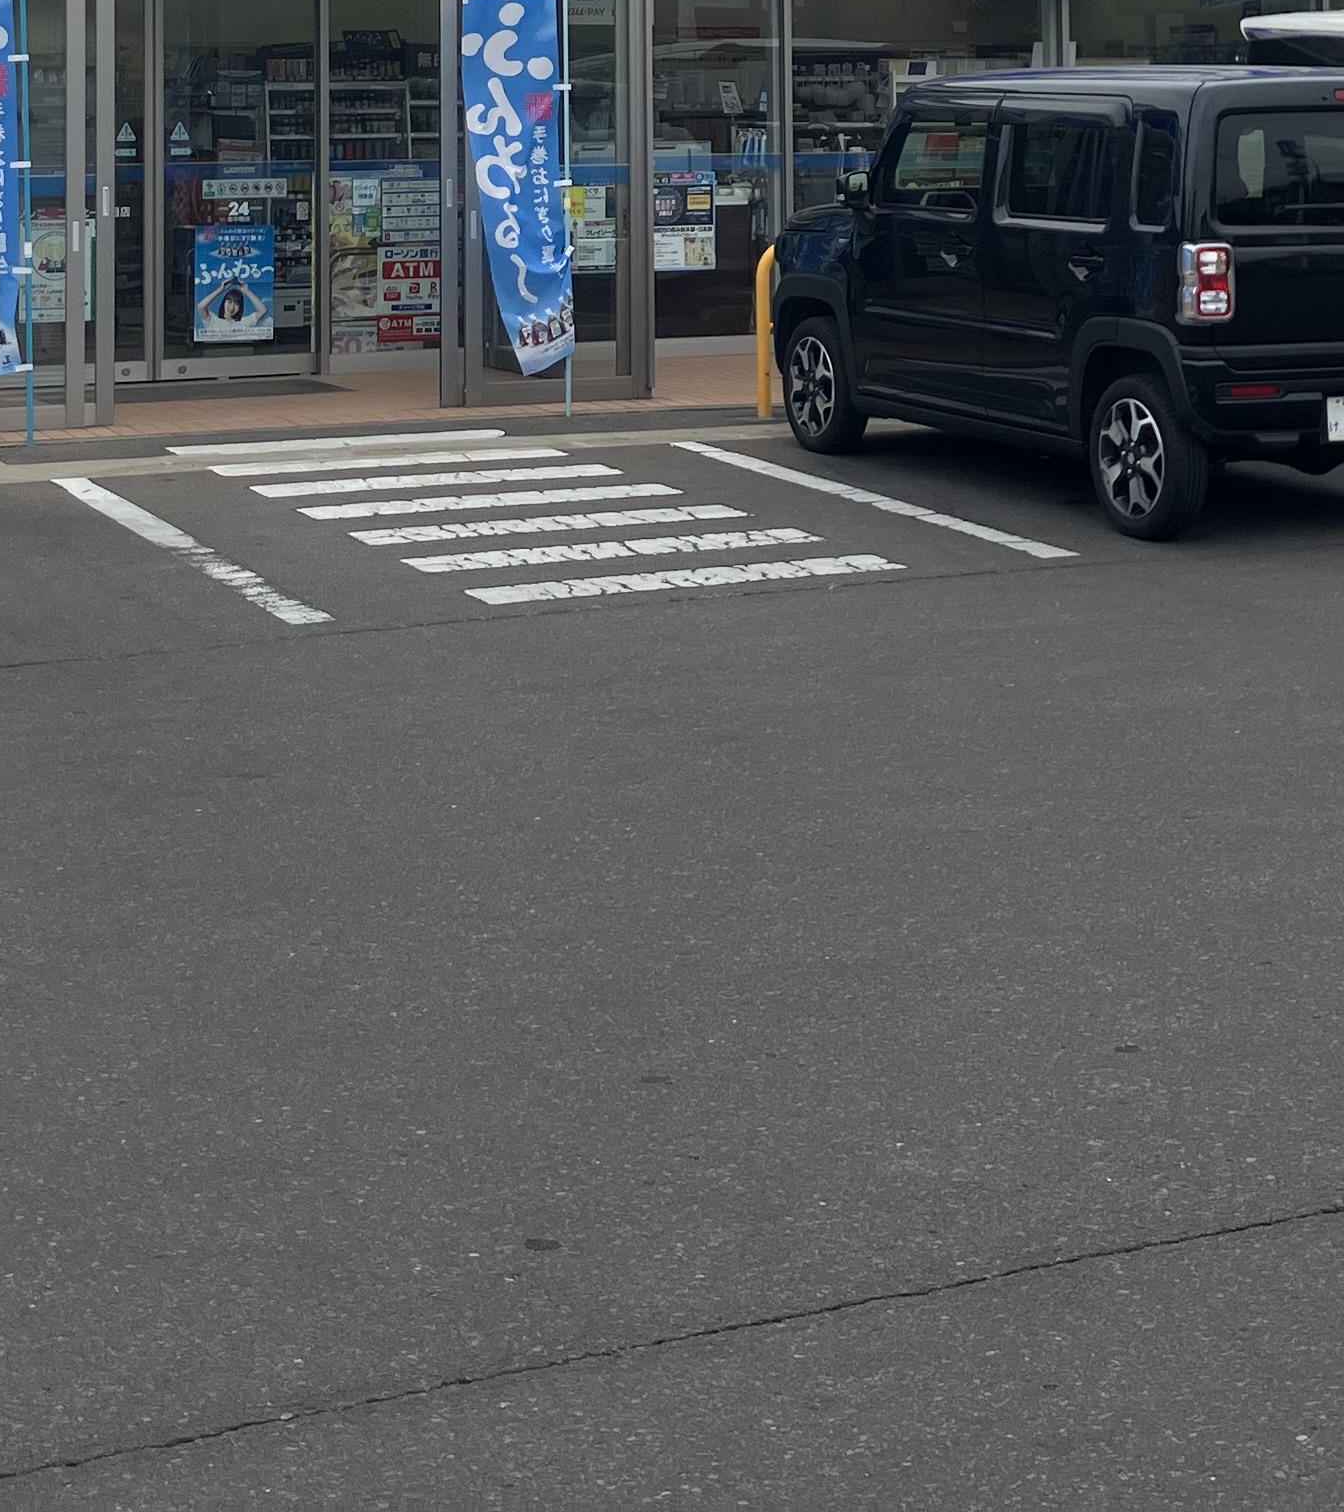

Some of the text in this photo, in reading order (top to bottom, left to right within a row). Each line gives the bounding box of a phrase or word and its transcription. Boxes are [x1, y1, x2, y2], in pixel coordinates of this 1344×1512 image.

[588, 7, 605, 16] PAY
[228, 201, 250, 216] 24
[385, 248, 439, 259] ローソン銀行
[391, 262, 434, 278] ATM
[391, 318, 412, 328] ATM
